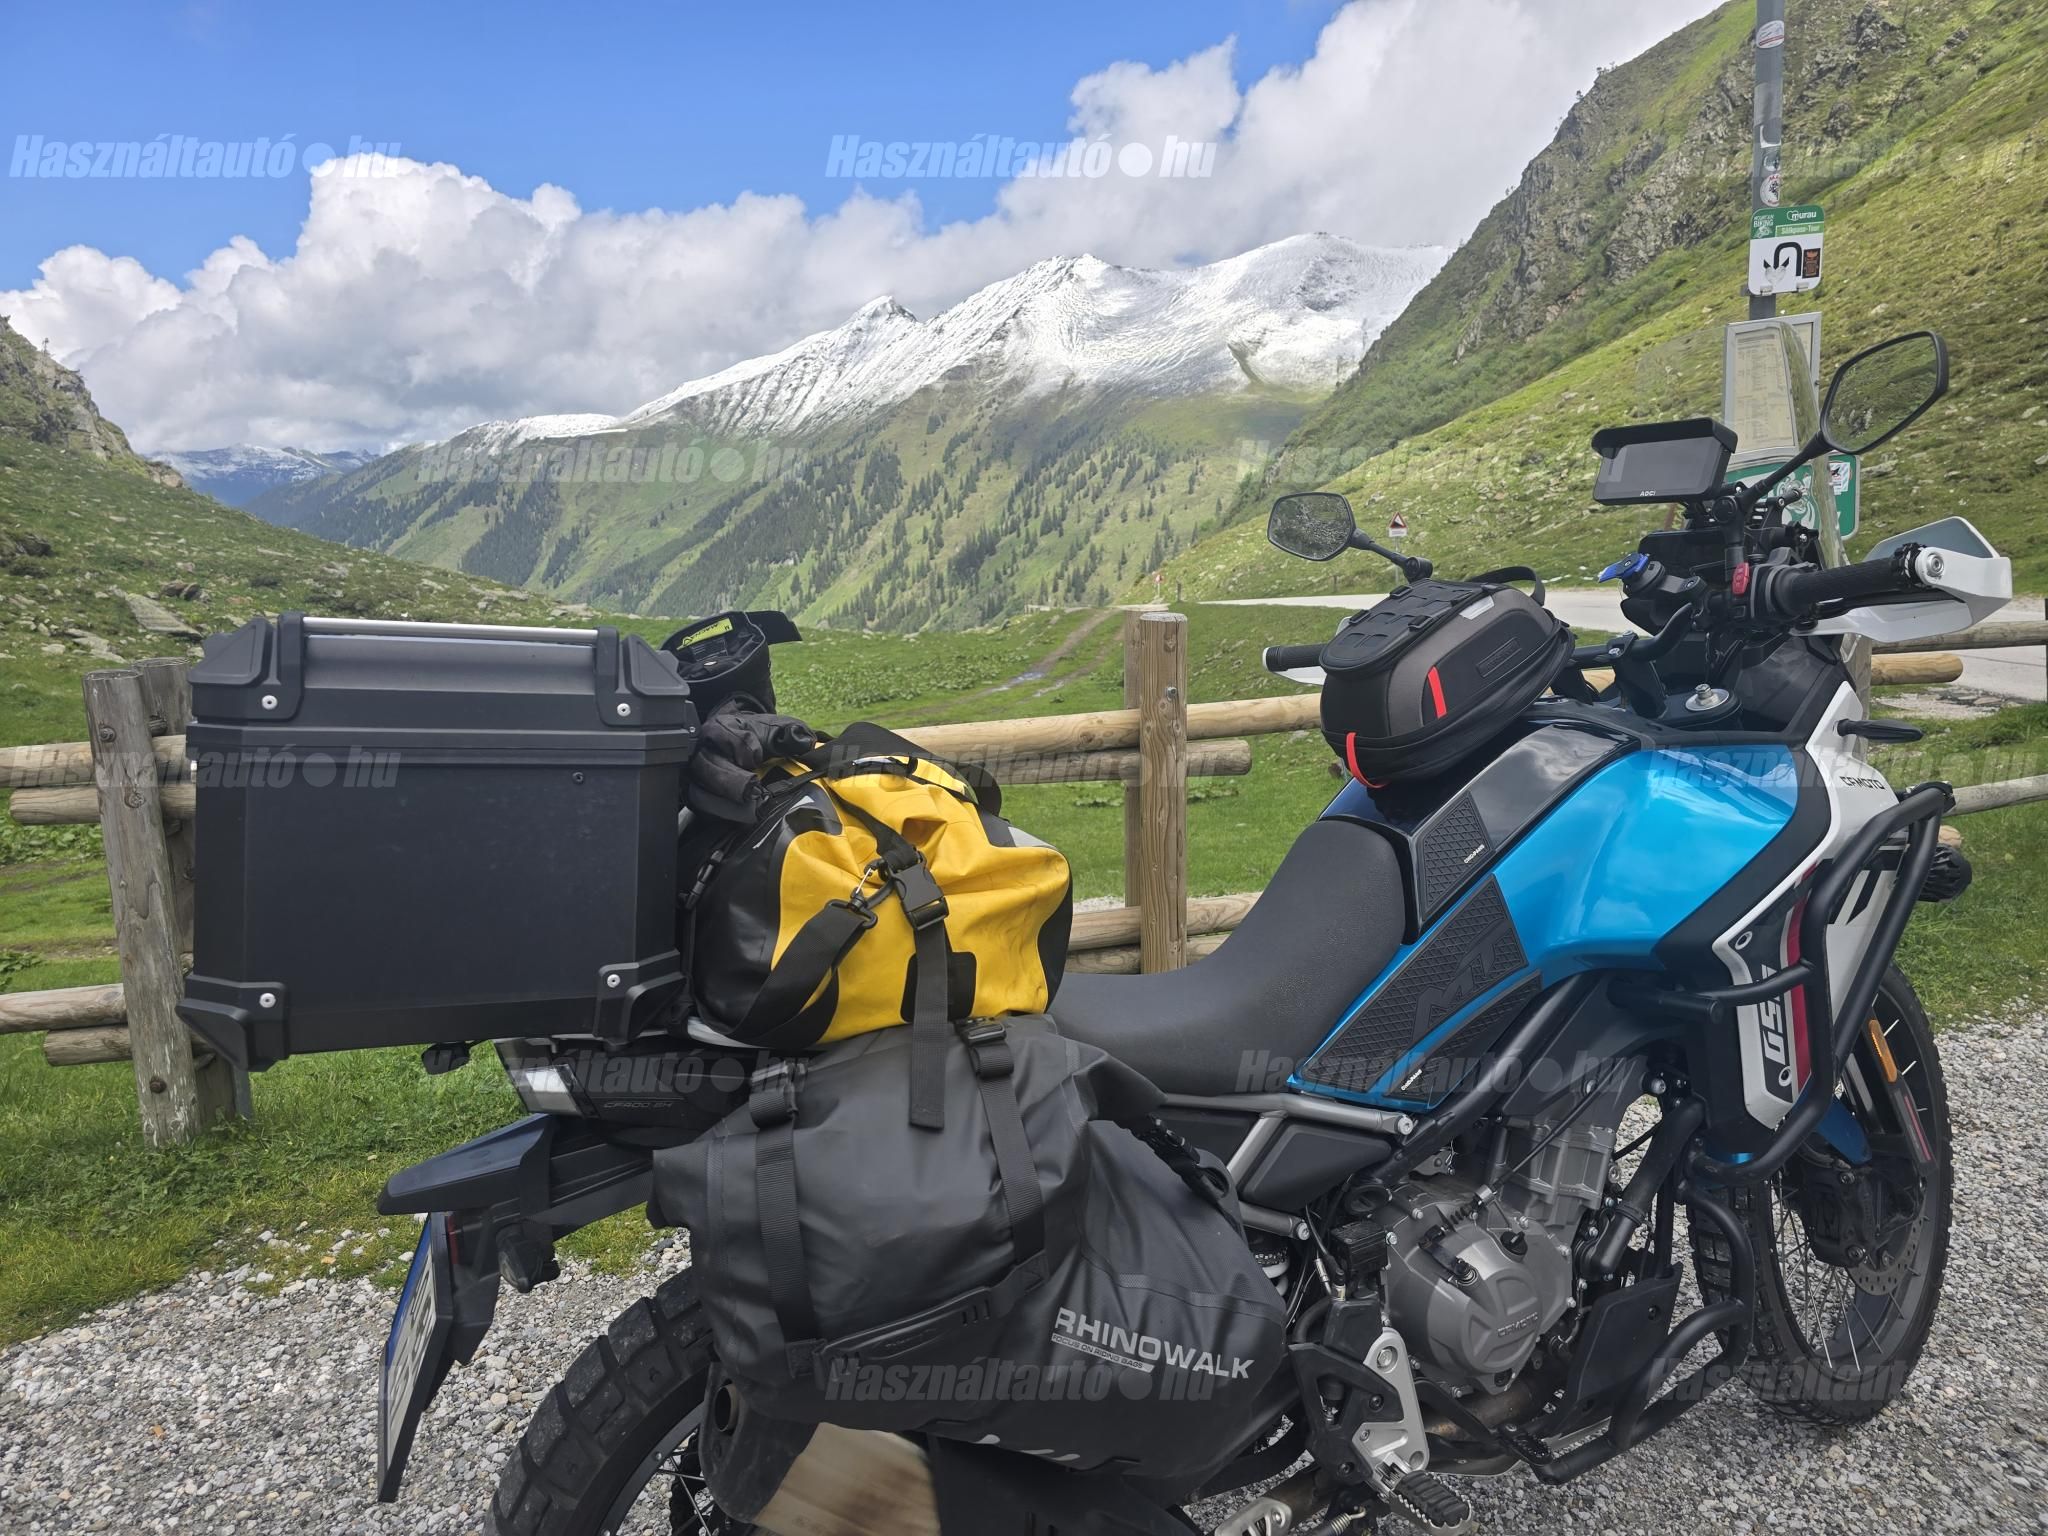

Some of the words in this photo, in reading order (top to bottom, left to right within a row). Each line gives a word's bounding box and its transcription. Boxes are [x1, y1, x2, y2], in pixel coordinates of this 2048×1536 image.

[1791, 211, 1817, 220] murau
[1839, 776, 1886, 790] CFMOTO
[1052, 1334, 1080, 1349] FOCUS
[1080, 1344, 1094, 1354] ON
[1093, 1348, 1121, 1362] RIDING
[1120, 1357, 1144, 1369] BAGS
[1054, 1307, 1255, 1379] RHINOWALK
